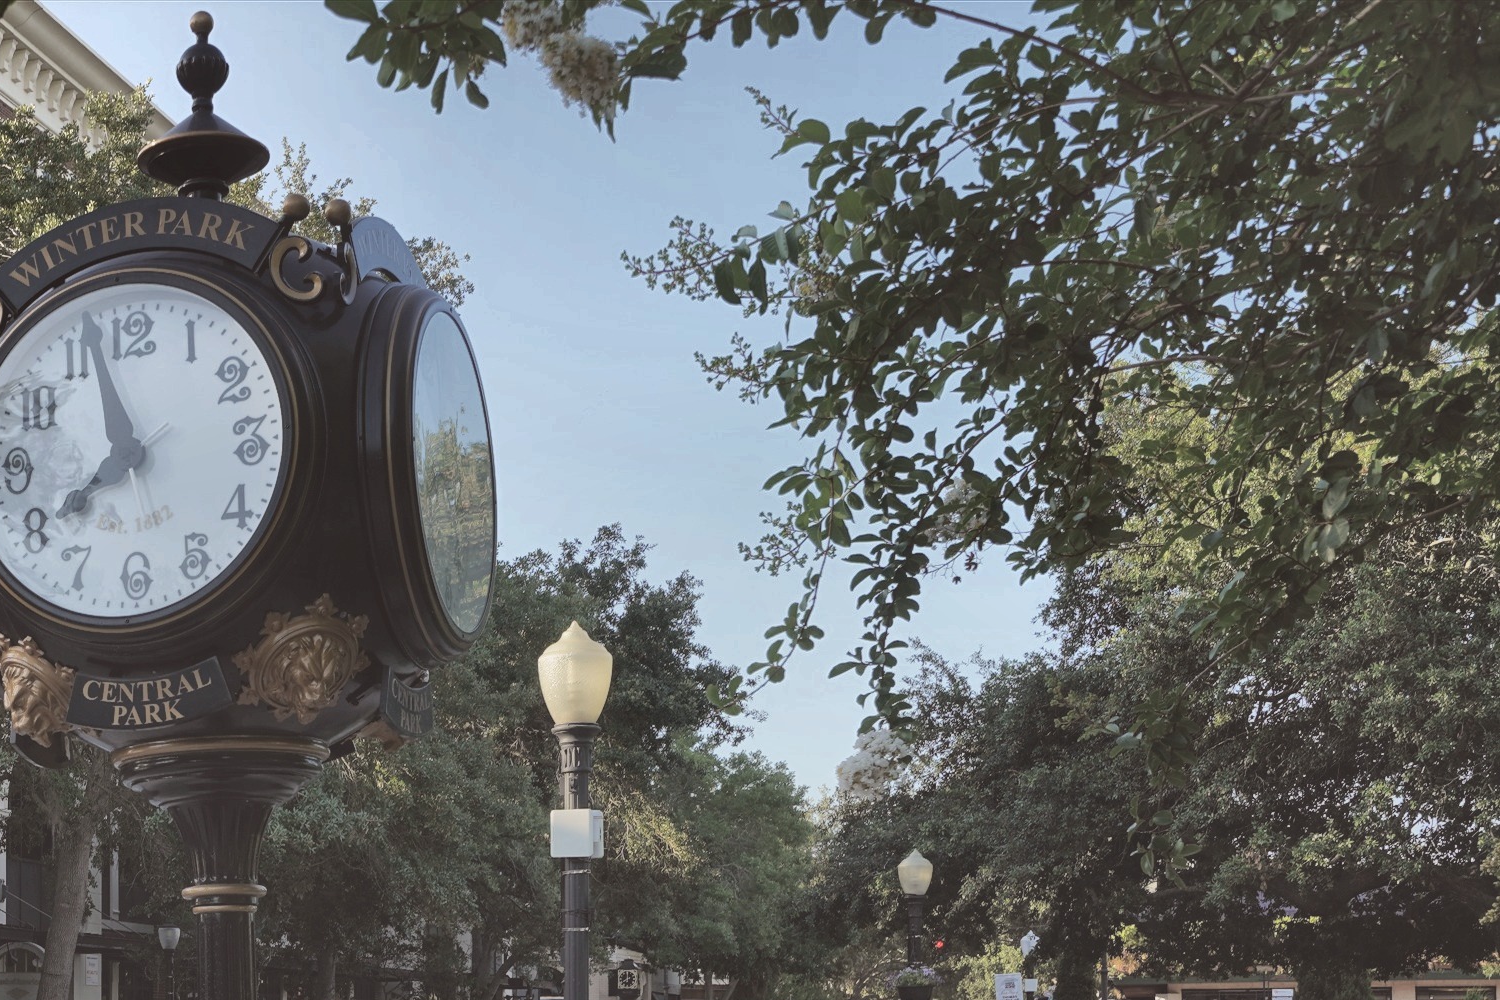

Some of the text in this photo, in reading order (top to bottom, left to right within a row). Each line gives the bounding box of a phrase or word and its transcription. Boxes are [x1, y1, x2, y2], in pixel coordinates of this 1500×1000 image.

[9, 208, 254, 288] WINTER PARK
[65, 337, 90, 379] 11
[112, 311, 156, 360] 12
[185, 320, 198, 363] 1
[215, 356, 251, 404] 2
[21, 385, 57, 432] 10
[233, 414, 270, 466] 3
[2, 447, 34, 493] 9
[135, 504, 175, 534] 1882
[221, 484, 253, 530] 4
[23, 508, 49, 553] 8
[62, 546, 92, 592] 7
[120, 552, 152, 600] 6
[180, 532, 211, 580] 5
[82, 669, 212, 704] CENTRAL
[112, 698, 185, 726] PARK
[401, 708, 422, 734] PARK
